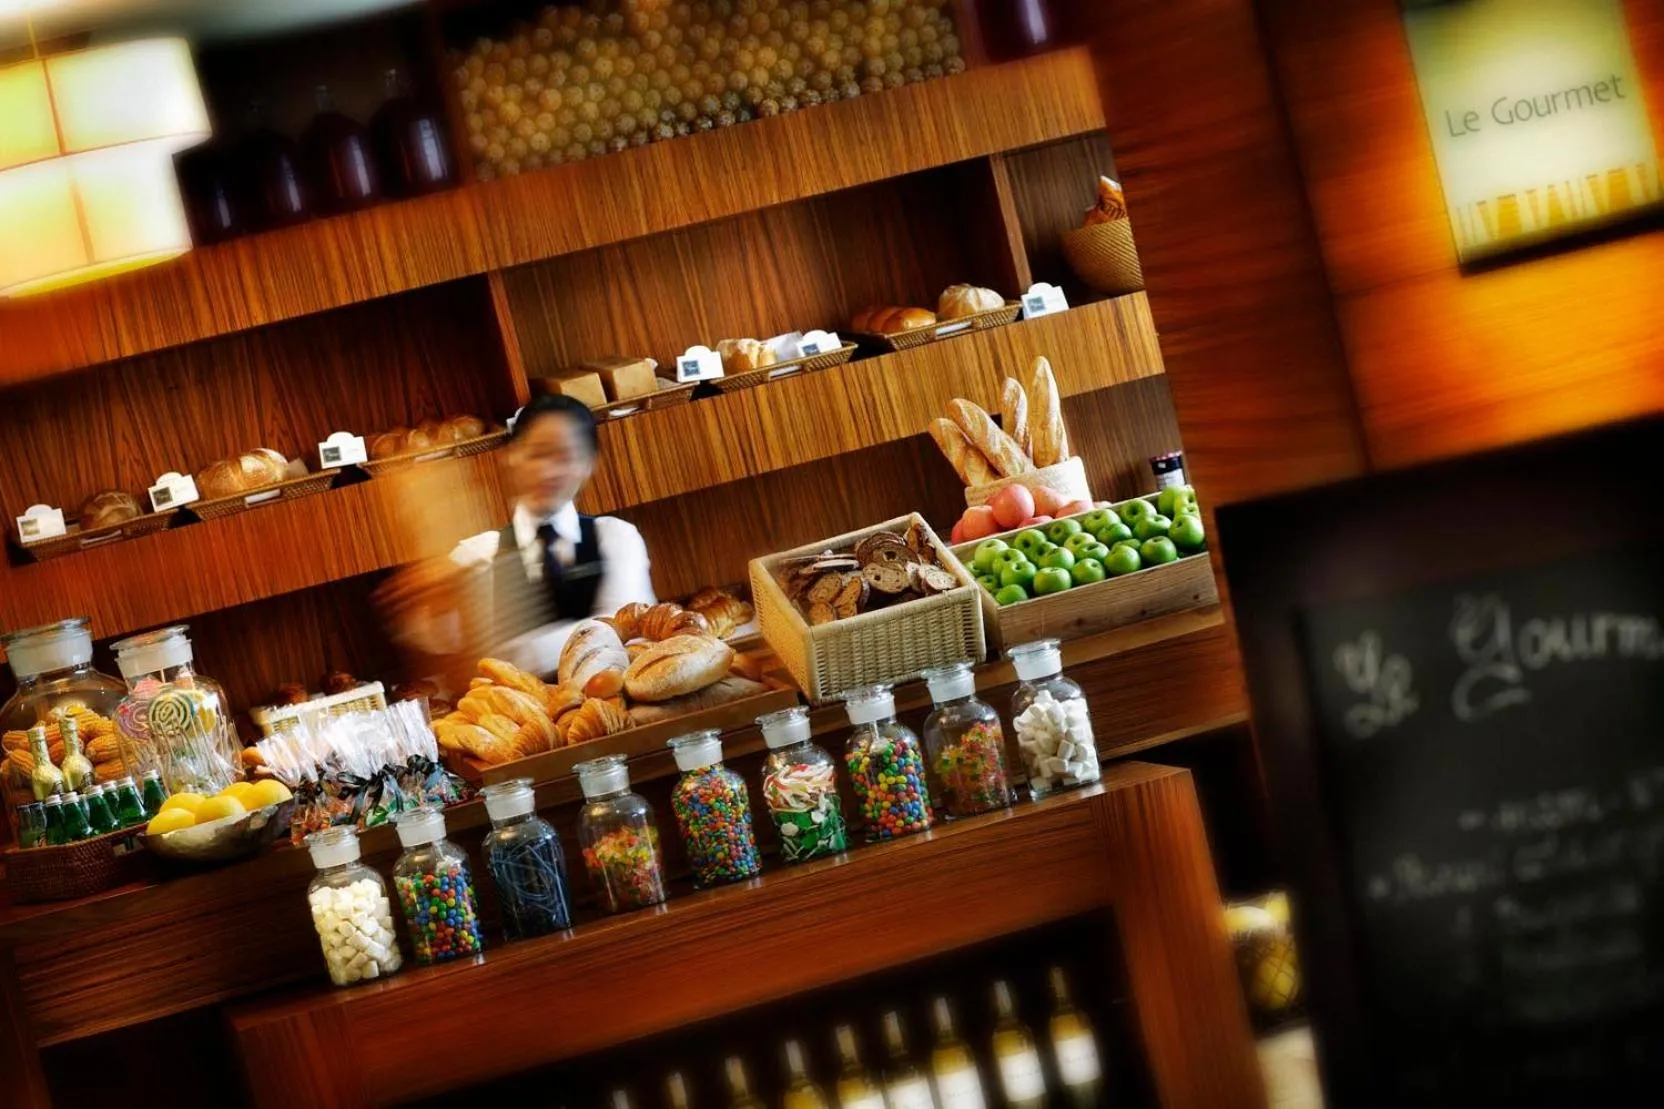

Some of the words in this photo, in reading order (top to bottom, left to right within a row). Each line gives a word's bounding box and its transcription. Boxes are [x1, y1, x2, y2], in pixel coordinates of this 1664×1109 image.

[1445, 109, 1482, 138] Le
[1490, 73, 1627, 126] Gourmet
[1449, 592, 1664, 722] Gourm
